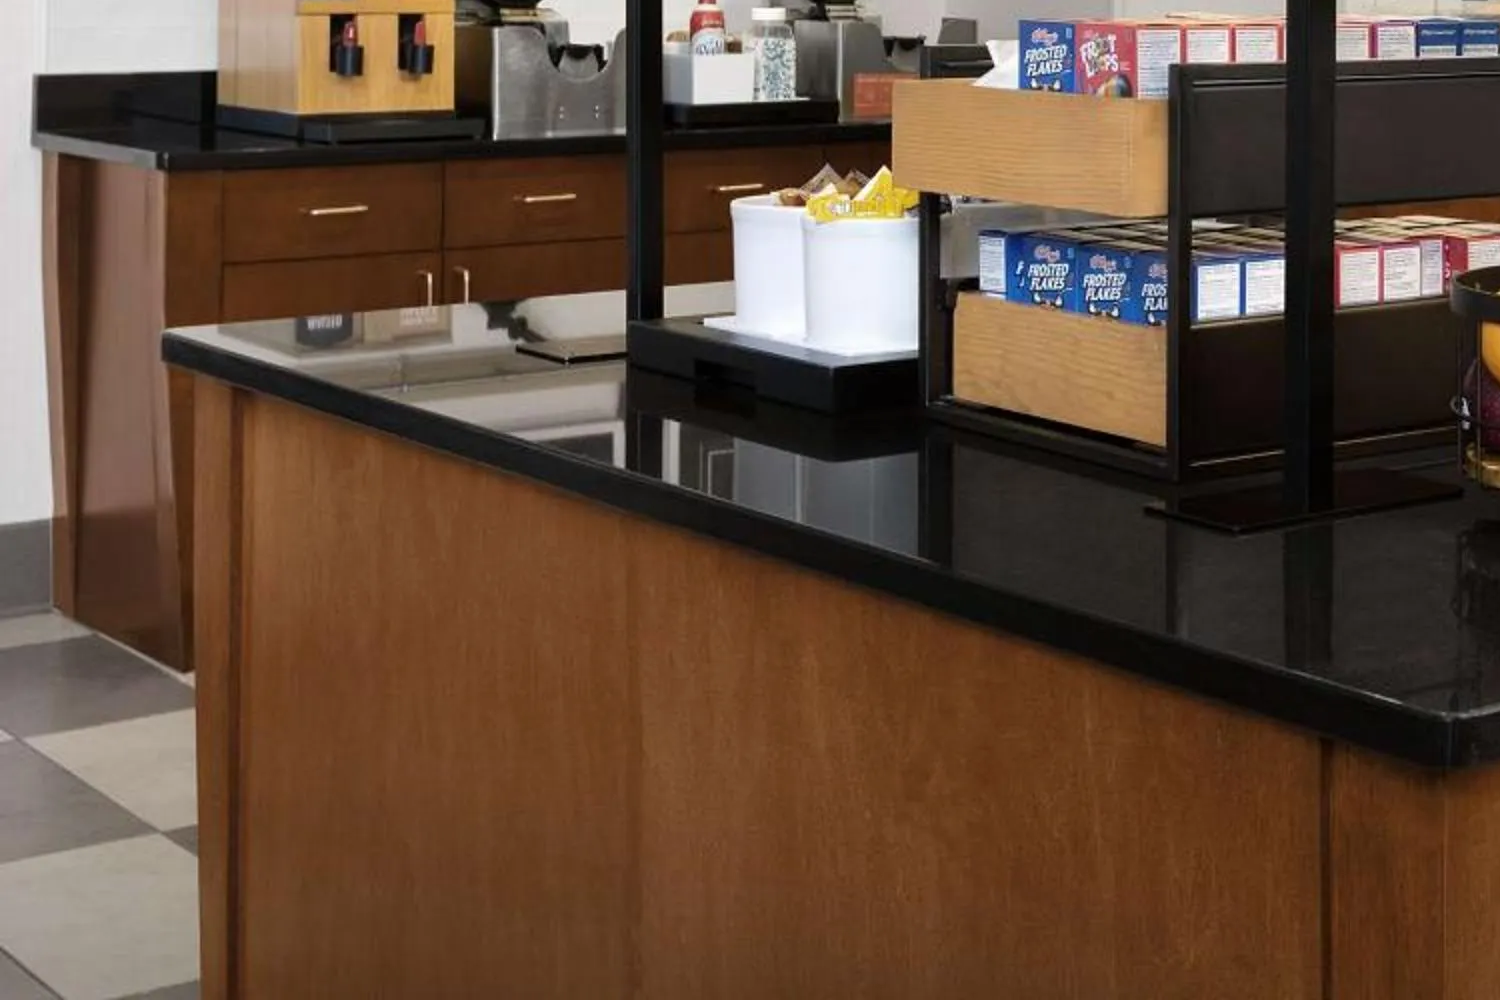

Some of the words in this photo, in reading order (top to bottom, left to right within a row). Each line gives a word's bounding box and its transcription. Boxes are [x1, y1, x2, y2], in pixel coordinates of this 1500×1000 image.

[1024, 44, 1068, 63] FROSTED
[1026, 59, 1063, 77] FLAKES
[1028, 263, 1069, 278] FROSTED
[1029, 277, 1066, 291] FLAKES
[1083, 273, 1127, 288] FROSTED
[1085, 286, 1122, 301] FLAKES
[1142, 283, 1167, 298] FROS
[1144, 297, 1167, 311] FLA
